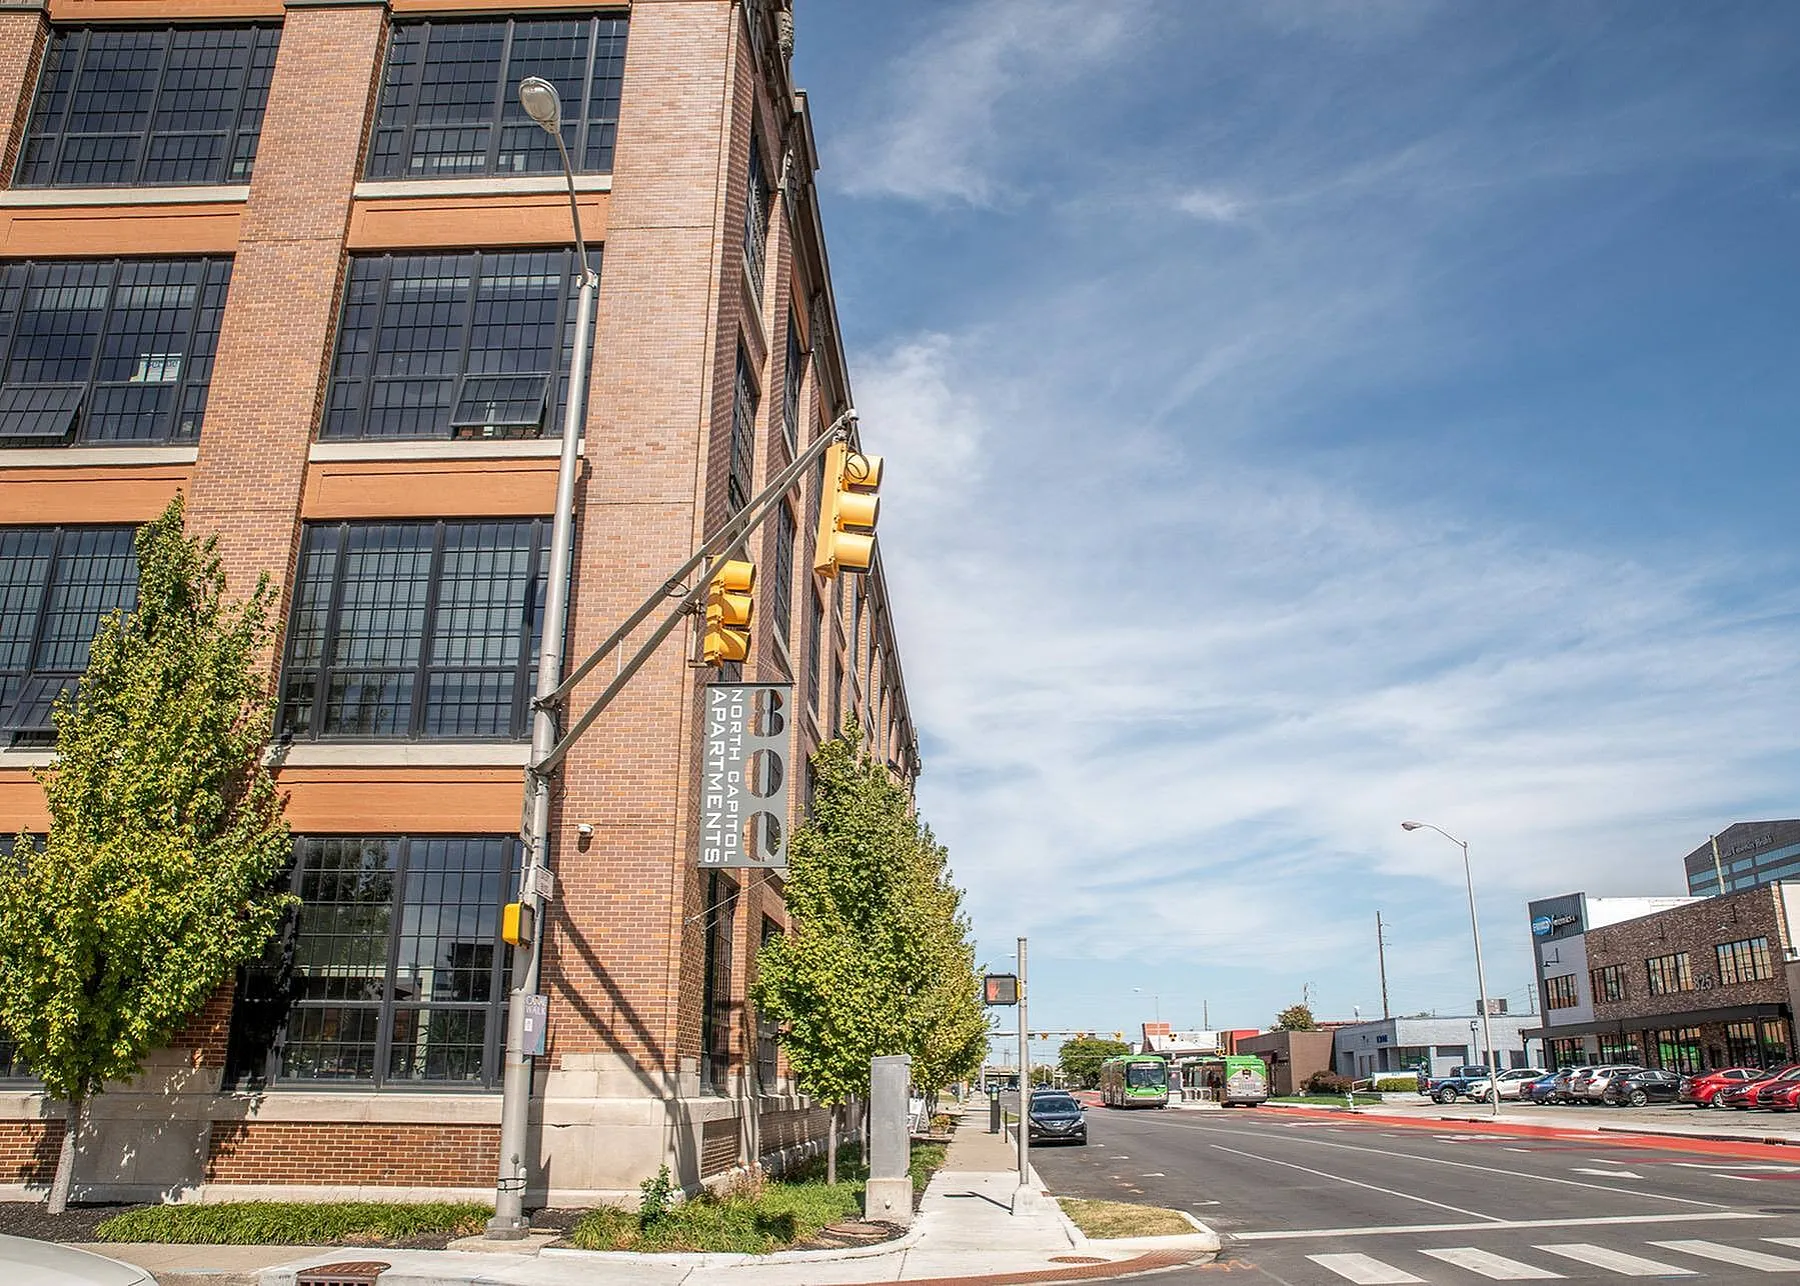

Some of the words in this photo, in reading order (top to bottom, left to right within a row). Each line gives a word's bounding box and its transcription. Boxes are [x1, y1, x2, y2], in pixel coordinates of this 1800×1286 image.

[704, 688, 727, 863] APARTMENTS
[729, 689, 744, 761] NORTH
[743, 688, 784, 862] 800
[724, 770, 740, 862] CAPITOL
